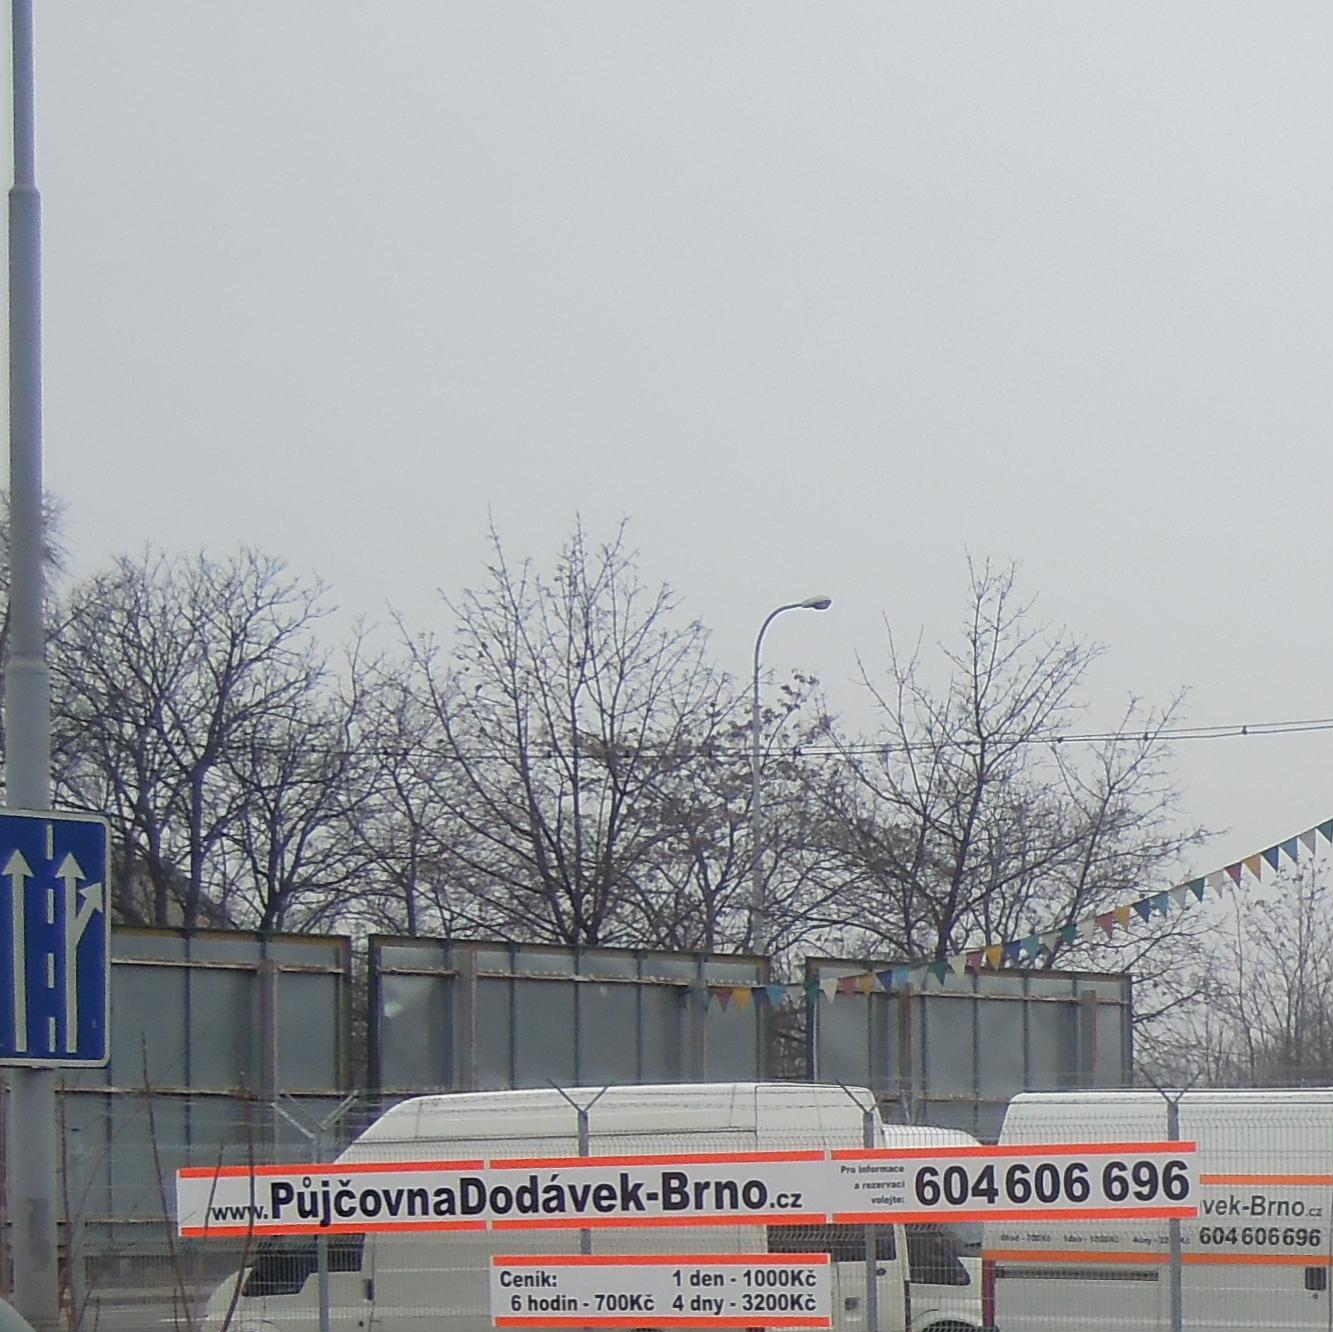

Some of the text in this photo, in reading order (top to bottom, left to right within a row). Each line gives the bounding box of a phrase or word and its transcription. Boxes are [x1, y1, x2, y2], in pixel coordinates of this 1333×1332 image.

[840, 1165, 905, 1174] Pro informace
[915, 1160, 1189, 1206] 604 606 696
[500, 1270, 558, 1288] Ceník:
[673, 1270, 681, 1287] 1
[690, 1270, 728, 1287] den
[743, 1269, 816, 1287] 1000Kč
[511, 1295, 521, 1311] 6
[528, 1294, 578, 1312] hodin
[595, 1294, 655, 1312] 700Kč
[672, 1295, 683, 1312] 4
[690, 1294, 724, 1315] dny
[742, 1294, 816, 1312] 3200Kč
